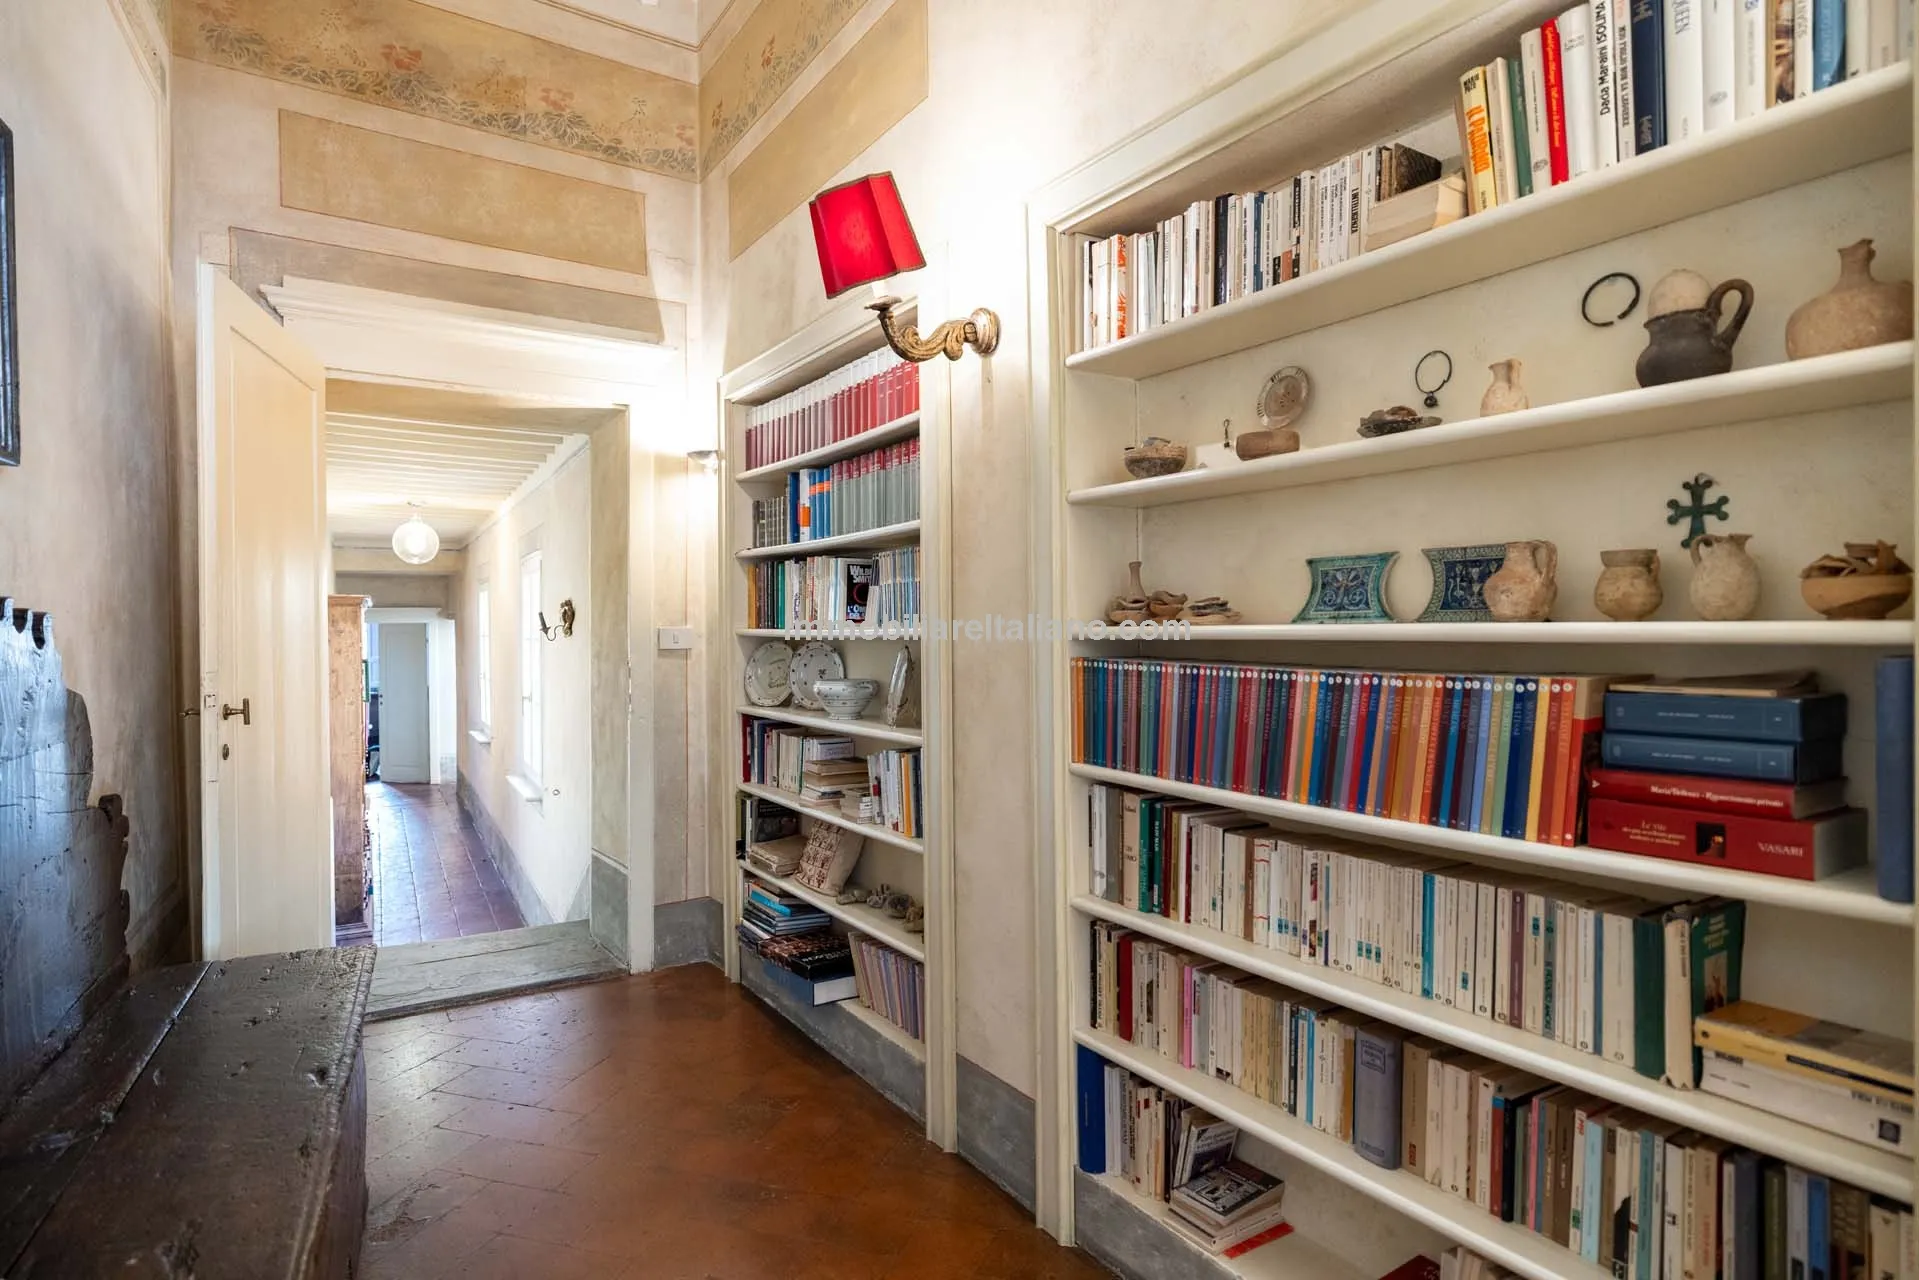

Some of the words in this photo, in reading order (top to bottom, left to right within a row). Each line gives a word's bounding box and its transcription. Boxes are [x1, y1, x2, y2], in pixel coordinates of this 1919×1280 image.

[1594, 1, 1608, 43] ISOLINA
[1597, 46, 1609, 85] Maraini
[1599, 87, 1611, 115] Dada
[852, 575, 871, 583] SMIT
[1758, 842, 1803, 857] VASARI
